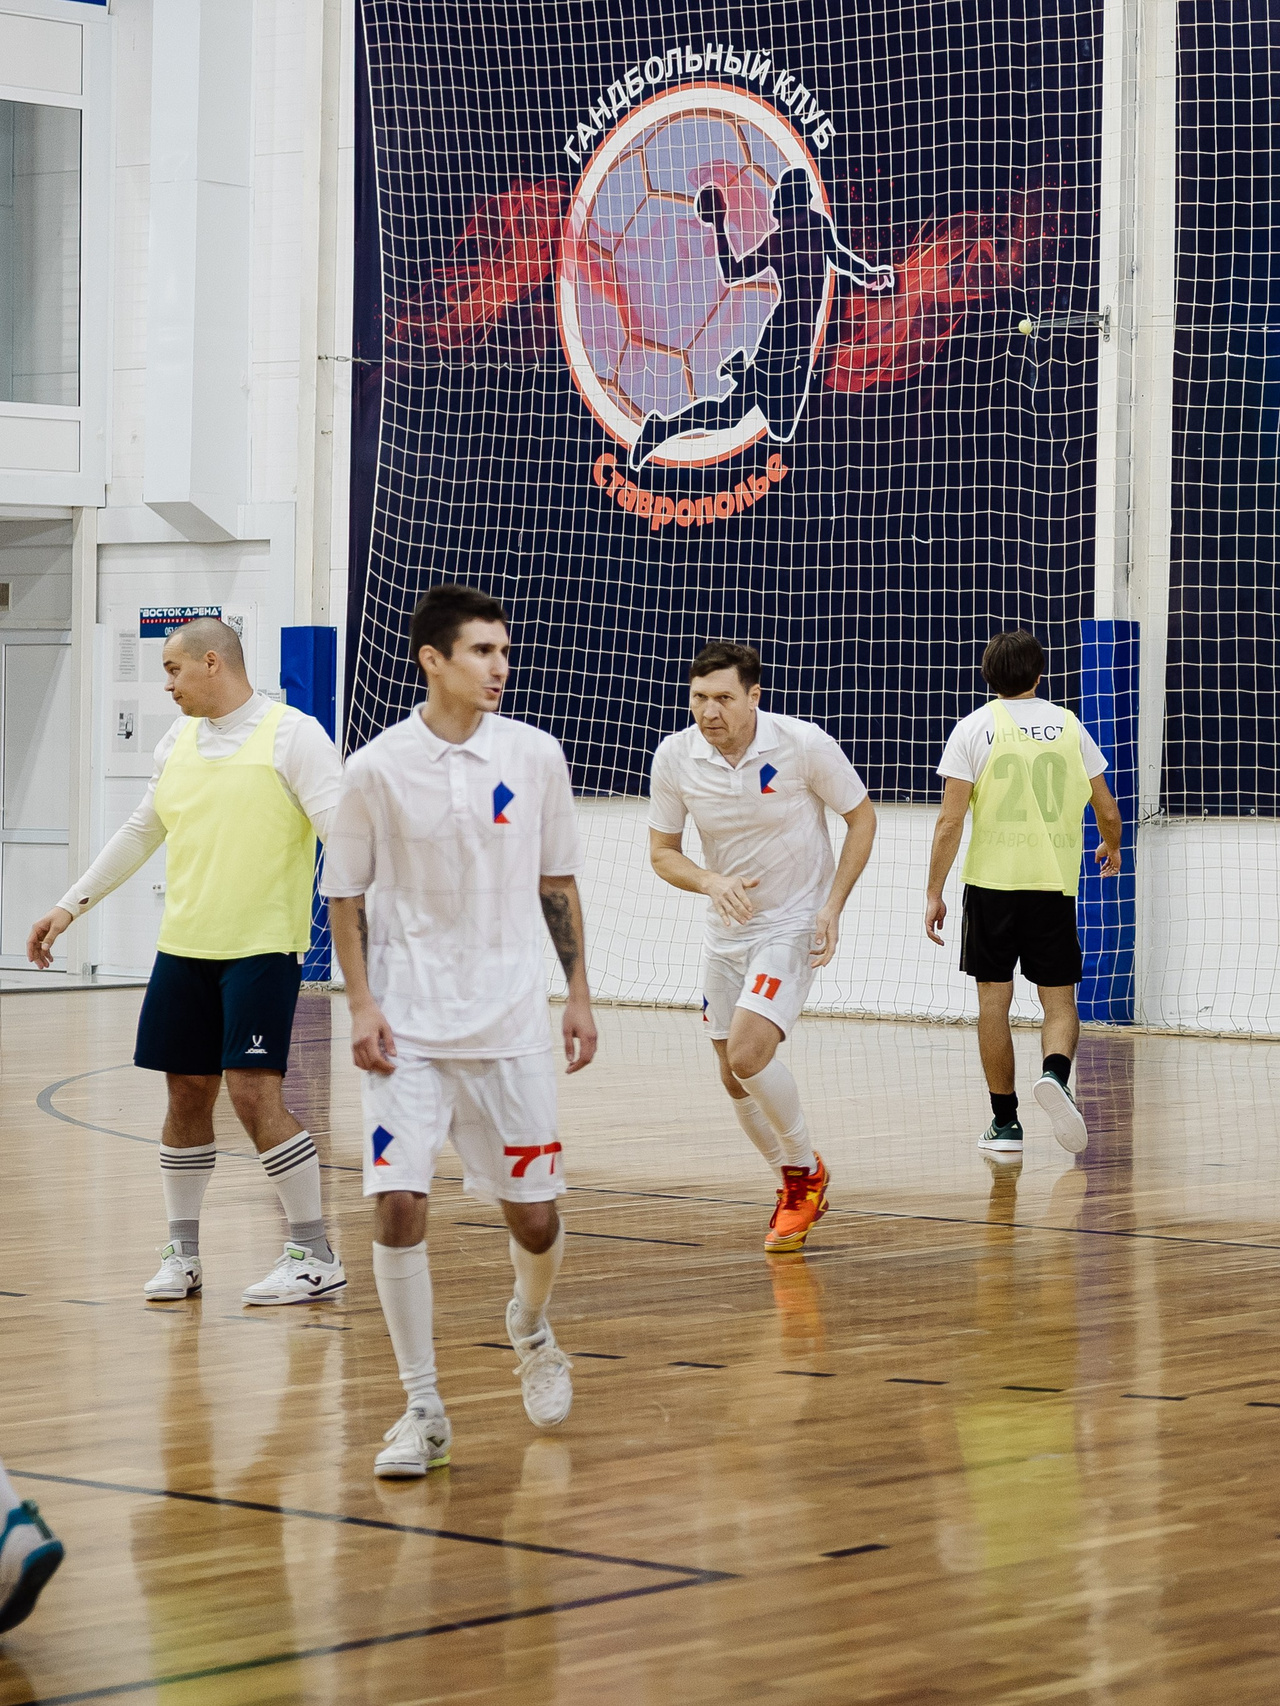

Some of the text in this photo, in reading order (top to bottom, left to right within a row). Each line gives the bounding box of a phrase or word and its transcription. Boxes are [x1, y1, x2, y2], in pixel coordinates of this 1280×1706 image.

[563, 43, 837, 163] ГАНДБОЛЬНЫЙ КЛУБ
[593, 452, 789, 531] Ставрополье
[993, 751, 1068, 823] 20
[751, 973, 783, 1001] 11
